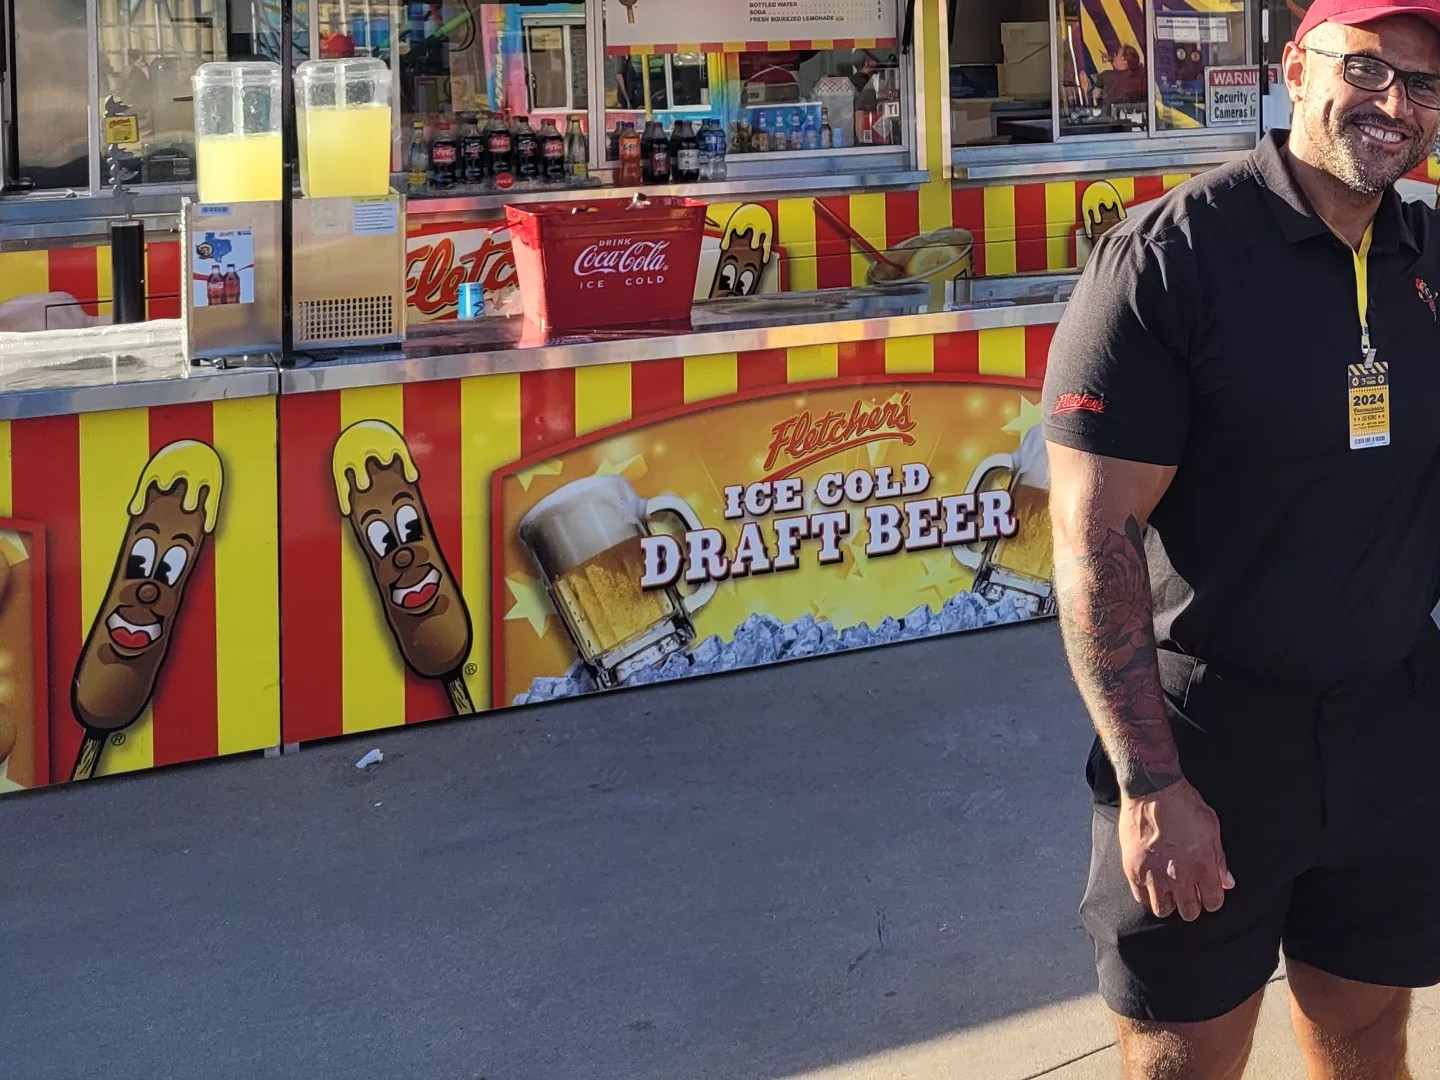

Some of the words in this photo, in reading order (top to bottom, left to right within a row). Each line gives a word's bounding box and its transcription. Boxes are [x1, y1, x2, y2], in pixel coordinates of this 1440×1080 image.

[1213, 69, 1275, 86] WARNIG
[1214, 91, 1248, 106] Security
[1214, 106, 1248, 119] Cameras
[598, 237, 631, 247] DRINK
[574, 240, 671, 277] Coca-Cola
[580, 279, 605, 289] ICE
[625, 275, 665, 286] COLD
[1353, 393, 1385, 407] 2024
[763, 390, 916, 473] Fletcher's
[724, 483, 804, 520] ICE
[817, 463, 932, 506] COLD
[640, 510, 852, 591] DRAFT
[865, 488, 1020, 563] BEER
